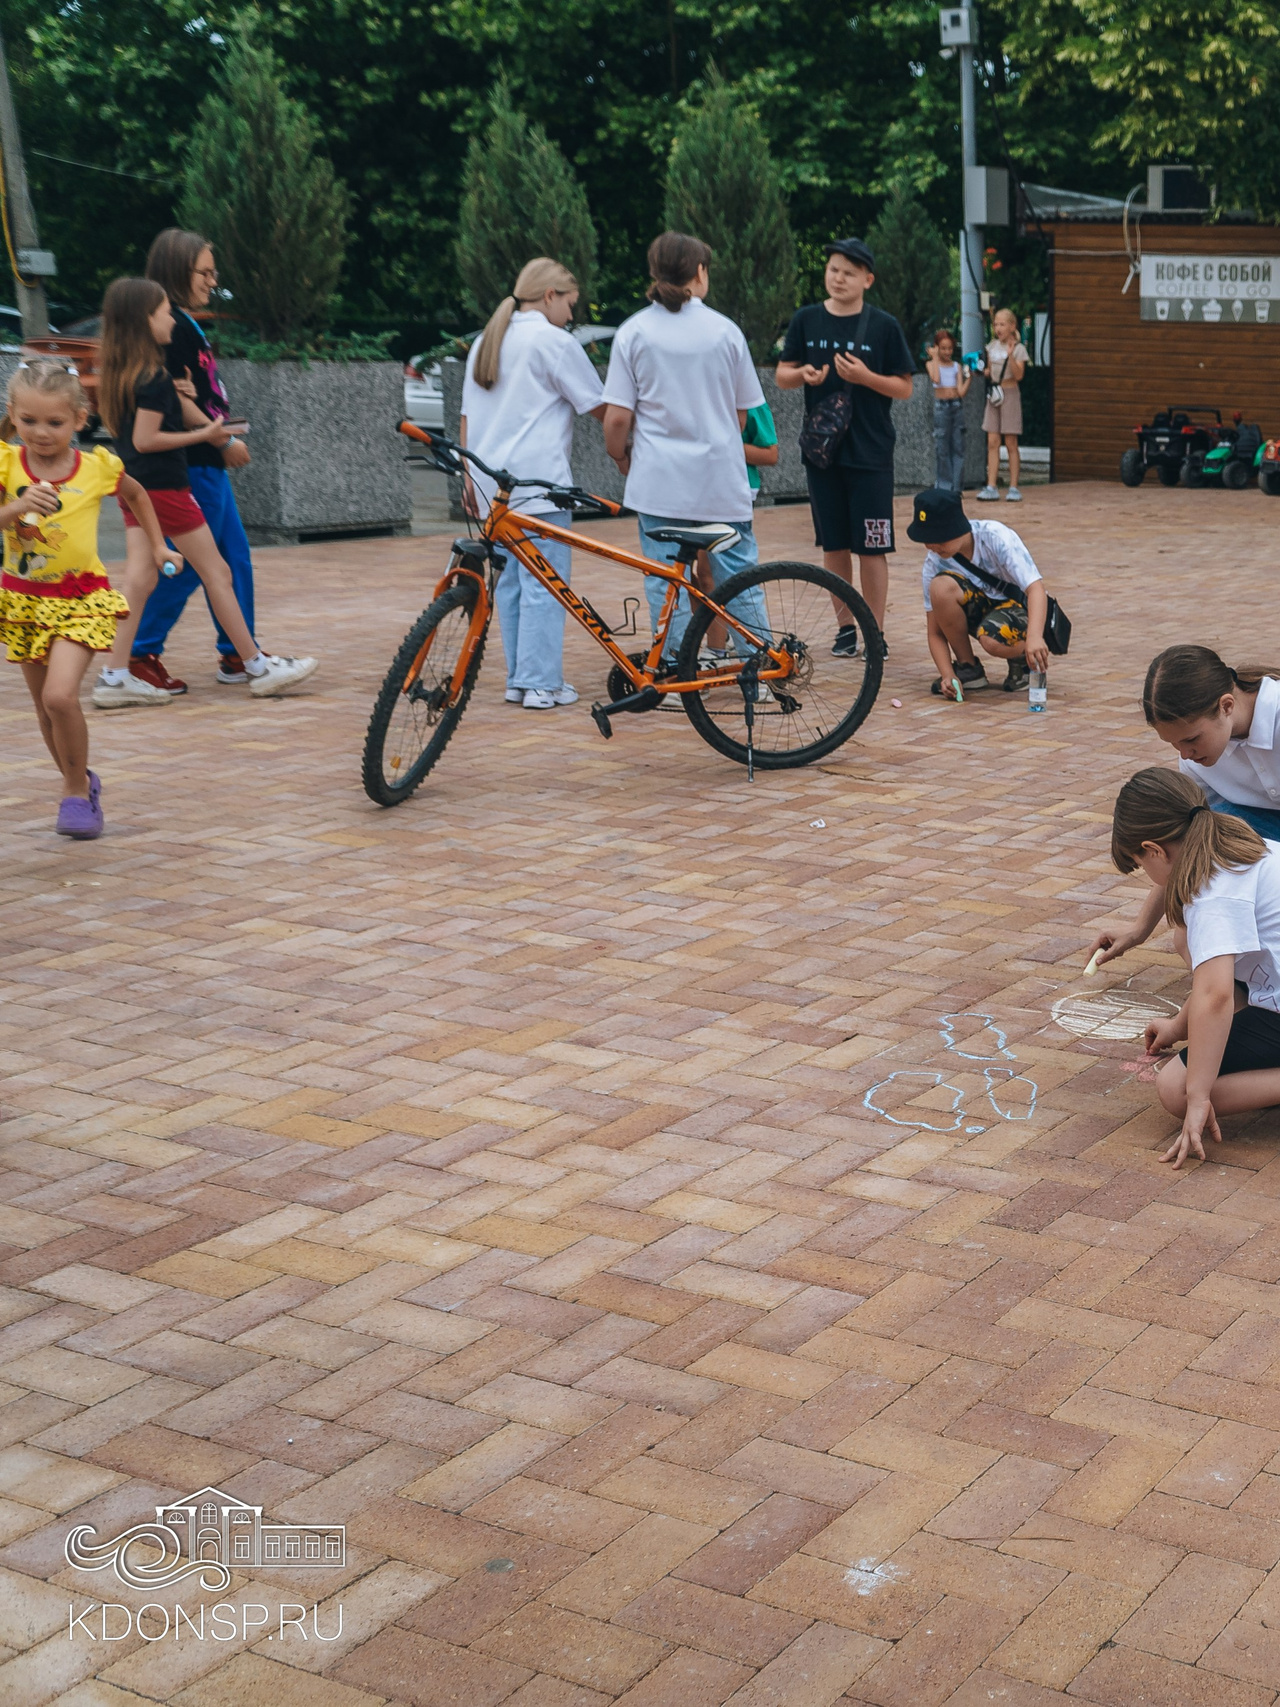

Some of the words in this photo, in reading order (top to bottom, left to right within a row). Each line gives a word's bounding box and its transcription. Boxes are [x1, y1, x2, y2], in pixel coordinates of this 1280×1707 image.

[1155, 262, 1200, 281] КОФЕ
[1204, 263, 1214, 281] С
[1218, 260, 1272, 282] СОБОЙ
[1155, 282, 1209, 297] COFFEE
[1219, 283, 1239, 297] TO
[1245, 283, 1272, 297] GO
[864, 518, 891, 548] H
[527, 553, 614, 643] STERN
